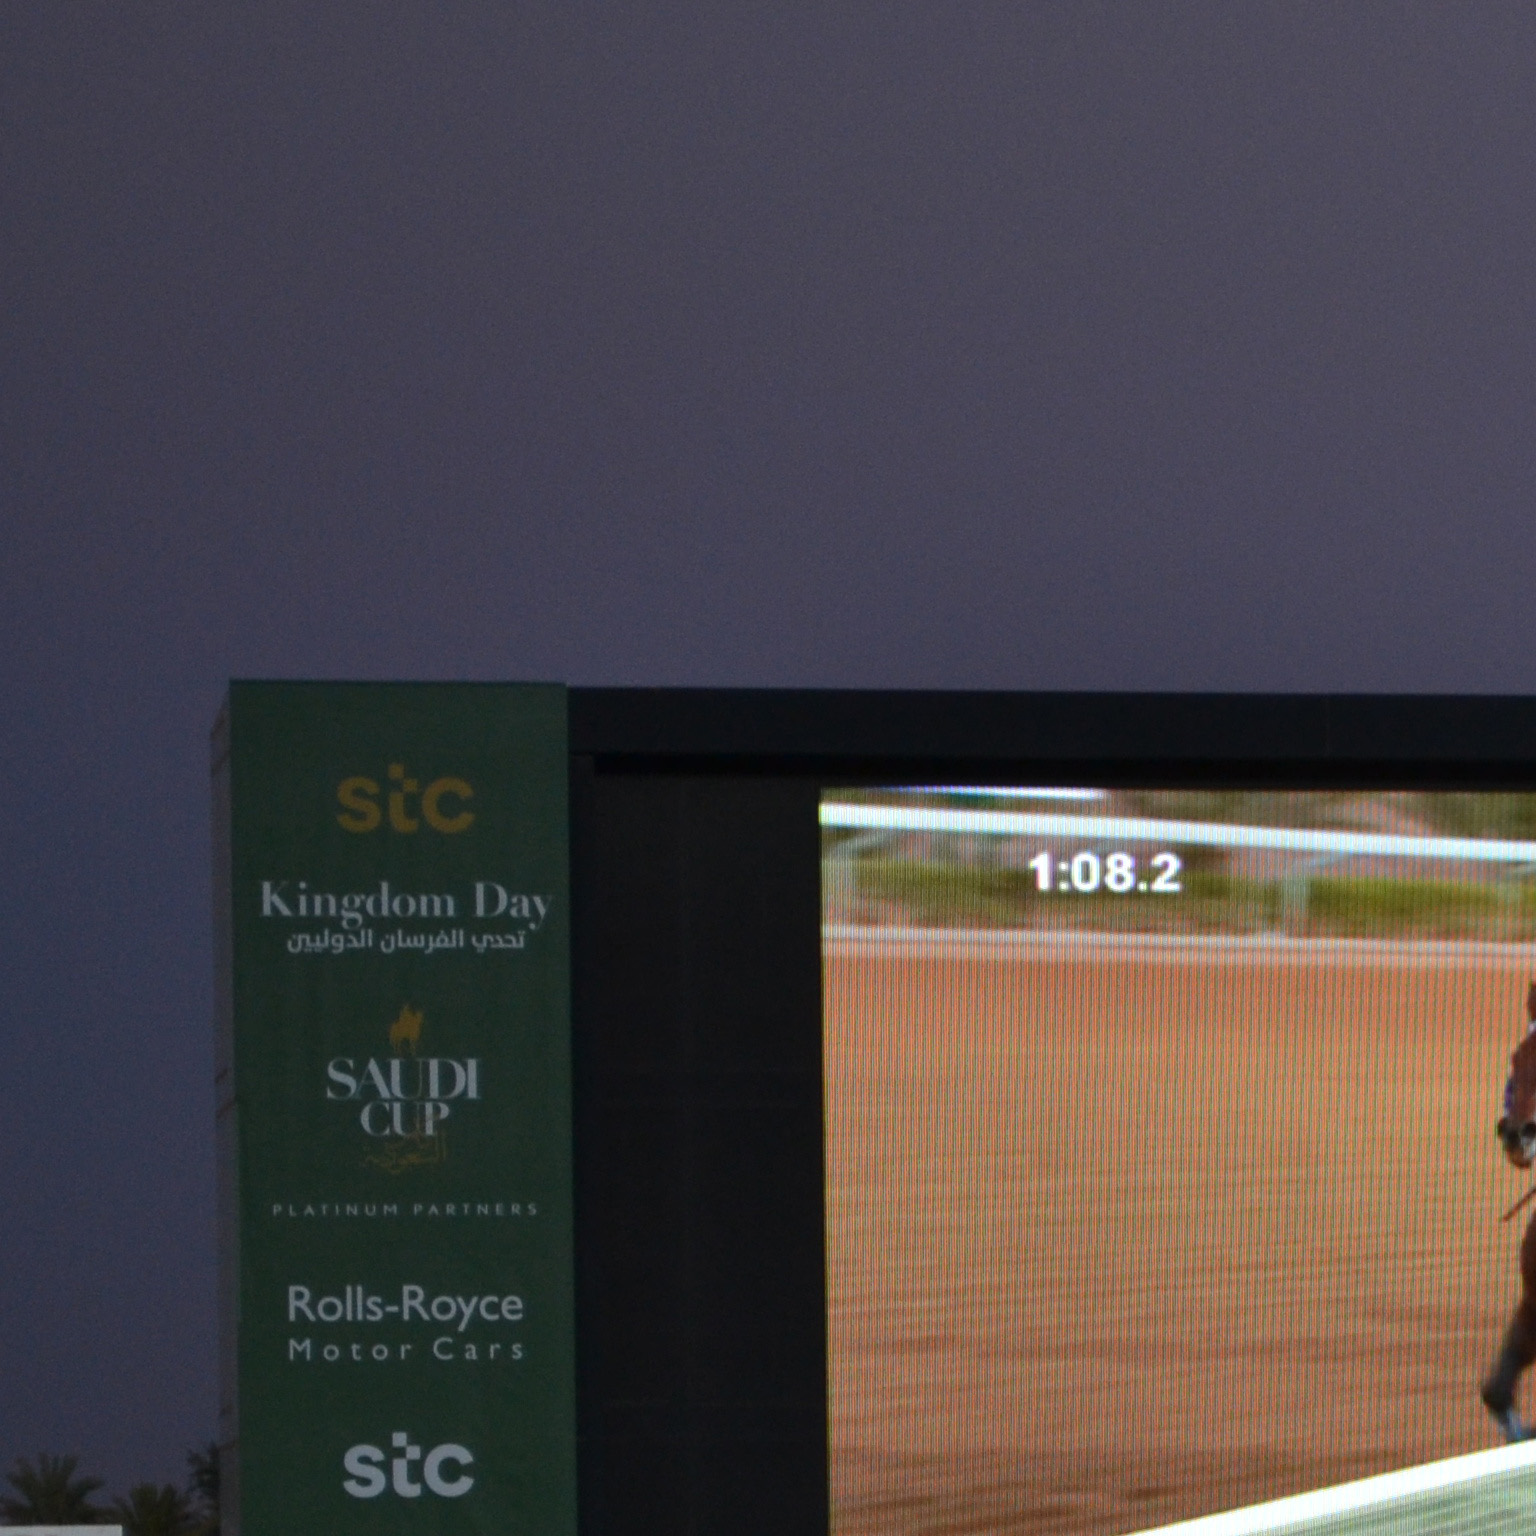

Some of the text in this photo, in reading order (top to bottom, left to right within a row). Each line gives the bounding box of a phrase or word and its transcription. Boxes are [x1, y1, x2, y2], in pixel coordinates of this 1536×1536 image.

[336, 762, 476, 834] stc
[1029, 852, 1181, 893] 1:08.2
[260, 880, 552, 930] Kingdom Day
[287, 928, 526, 954] تحدي الفرسان الدوليين
[327, 1057, 481, 1100] SAUDI
[361, 1101, 450, 1136] CUP
[273, 1202, 538, 1217] PLATINUM PARTNERS
[288, 1284, 524, 1332] Rolls-Royce
[289, 1337, 524, 1362] Motor Cars
[343, 1431, 475, 1499] stc
